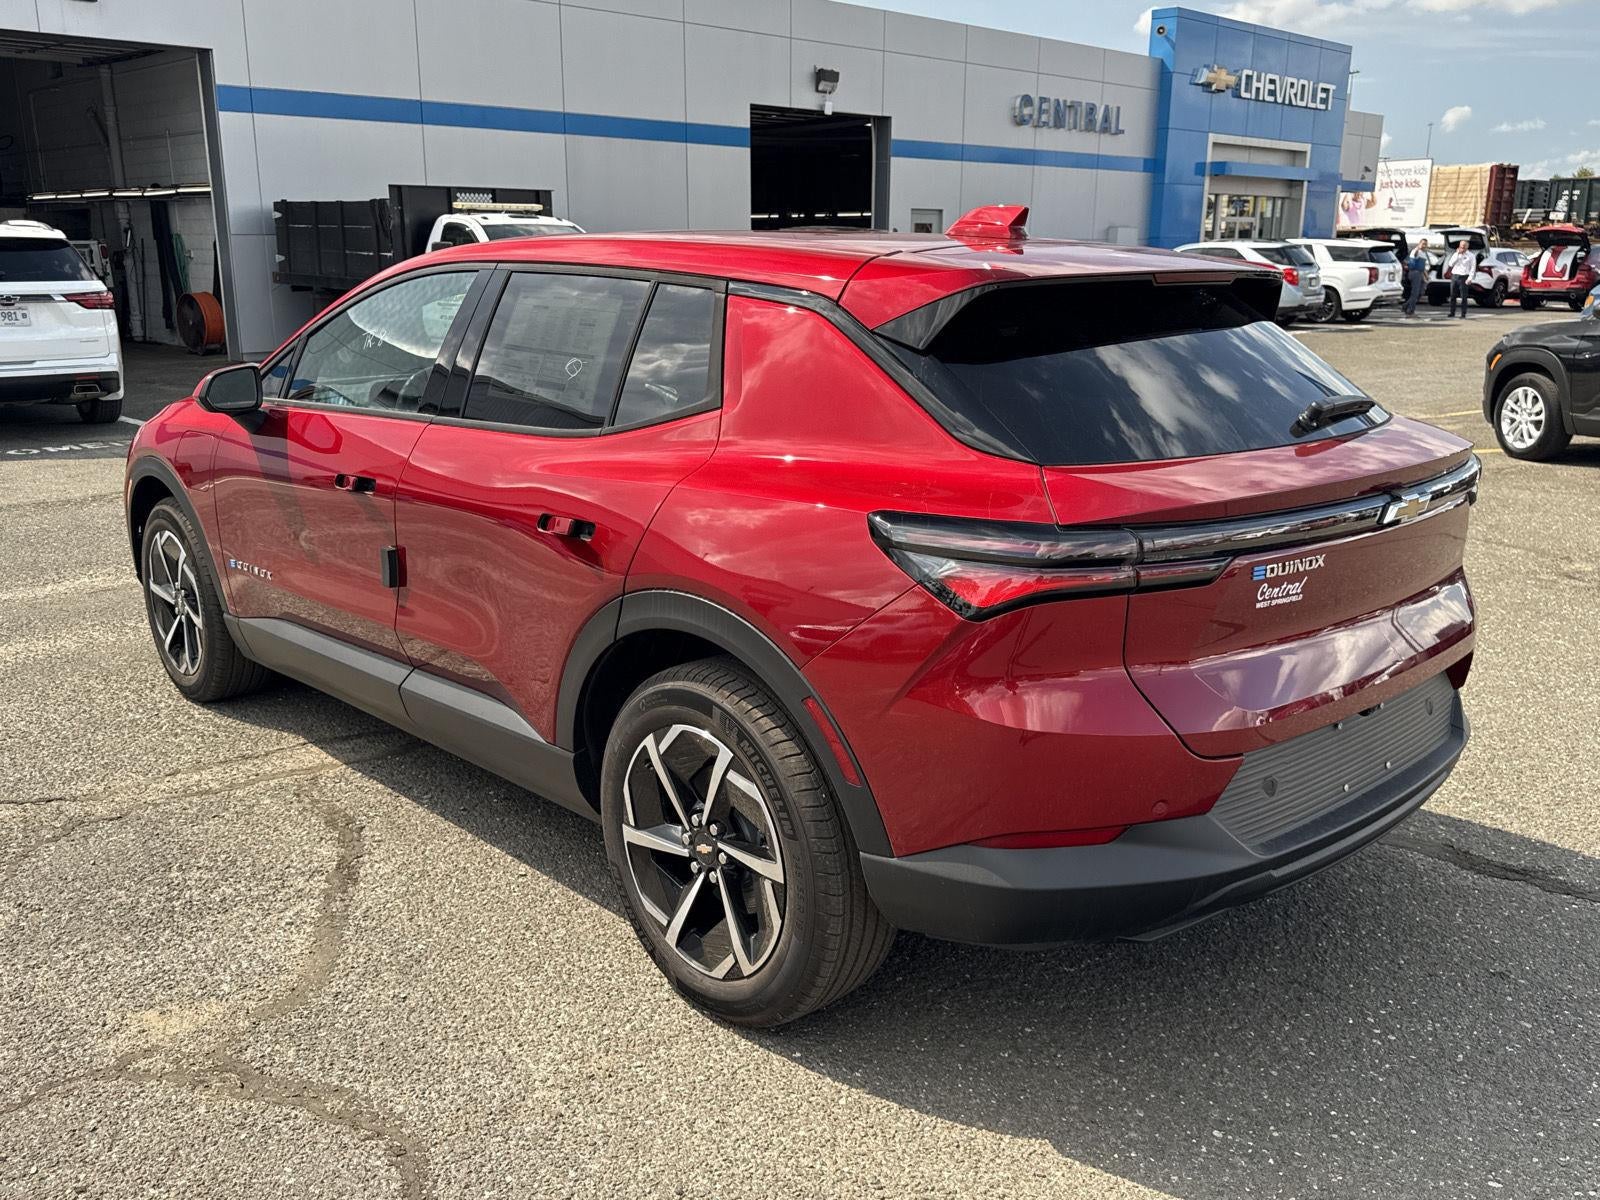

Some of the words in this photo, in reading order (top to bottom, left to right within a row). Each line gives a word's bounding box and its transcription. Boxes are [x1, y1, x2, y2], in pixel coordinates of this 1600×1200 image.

[1240, 69, 1337, 110] CHEVROLET
[1013, 94, 1125, 135] CENTRAL
[1251, 554, 1326, 580] EQUINOX
[1255, 600, 1271, 609] WEST
[1257, 576, 1308, 601] Central
[739, 739, 796, 838] MICHELIN
